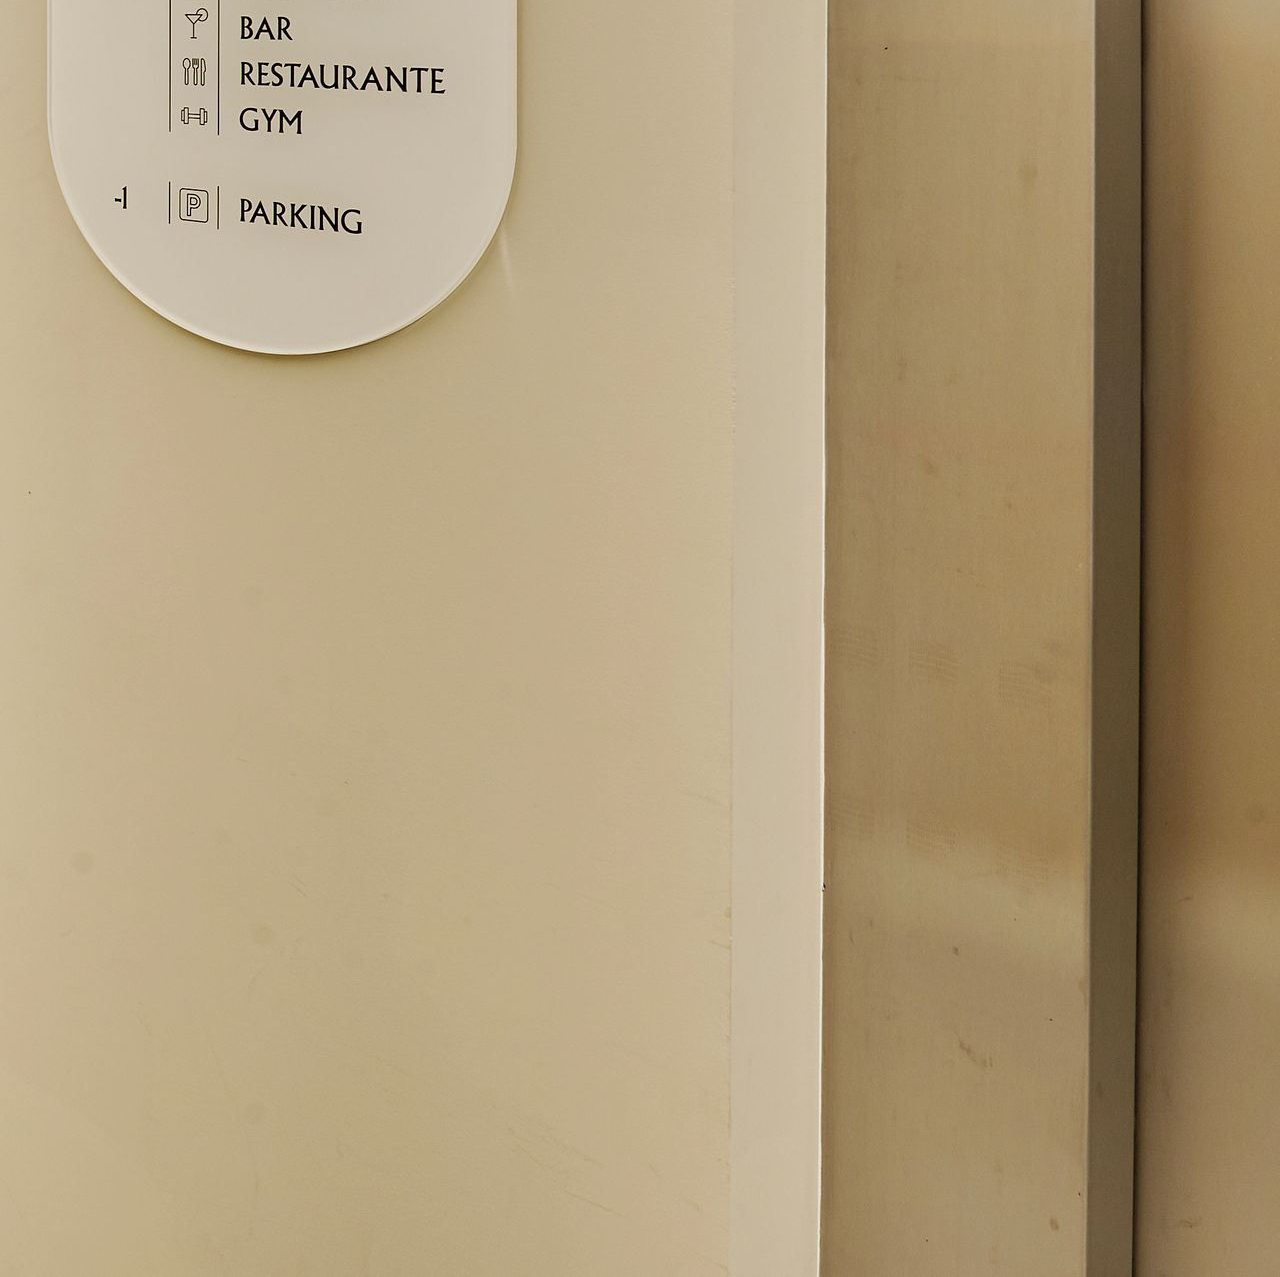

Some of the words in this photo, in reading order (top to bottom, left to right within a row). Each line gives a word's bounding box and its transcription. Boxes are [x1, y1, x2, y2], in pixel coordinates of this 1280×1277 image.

[240, 15, 294, 41] BAR
[240, 61, 447, 96] RESTAURANTE
[239, 107, 303, 135] GYM
[239, 198, 363, 235] PARKING
